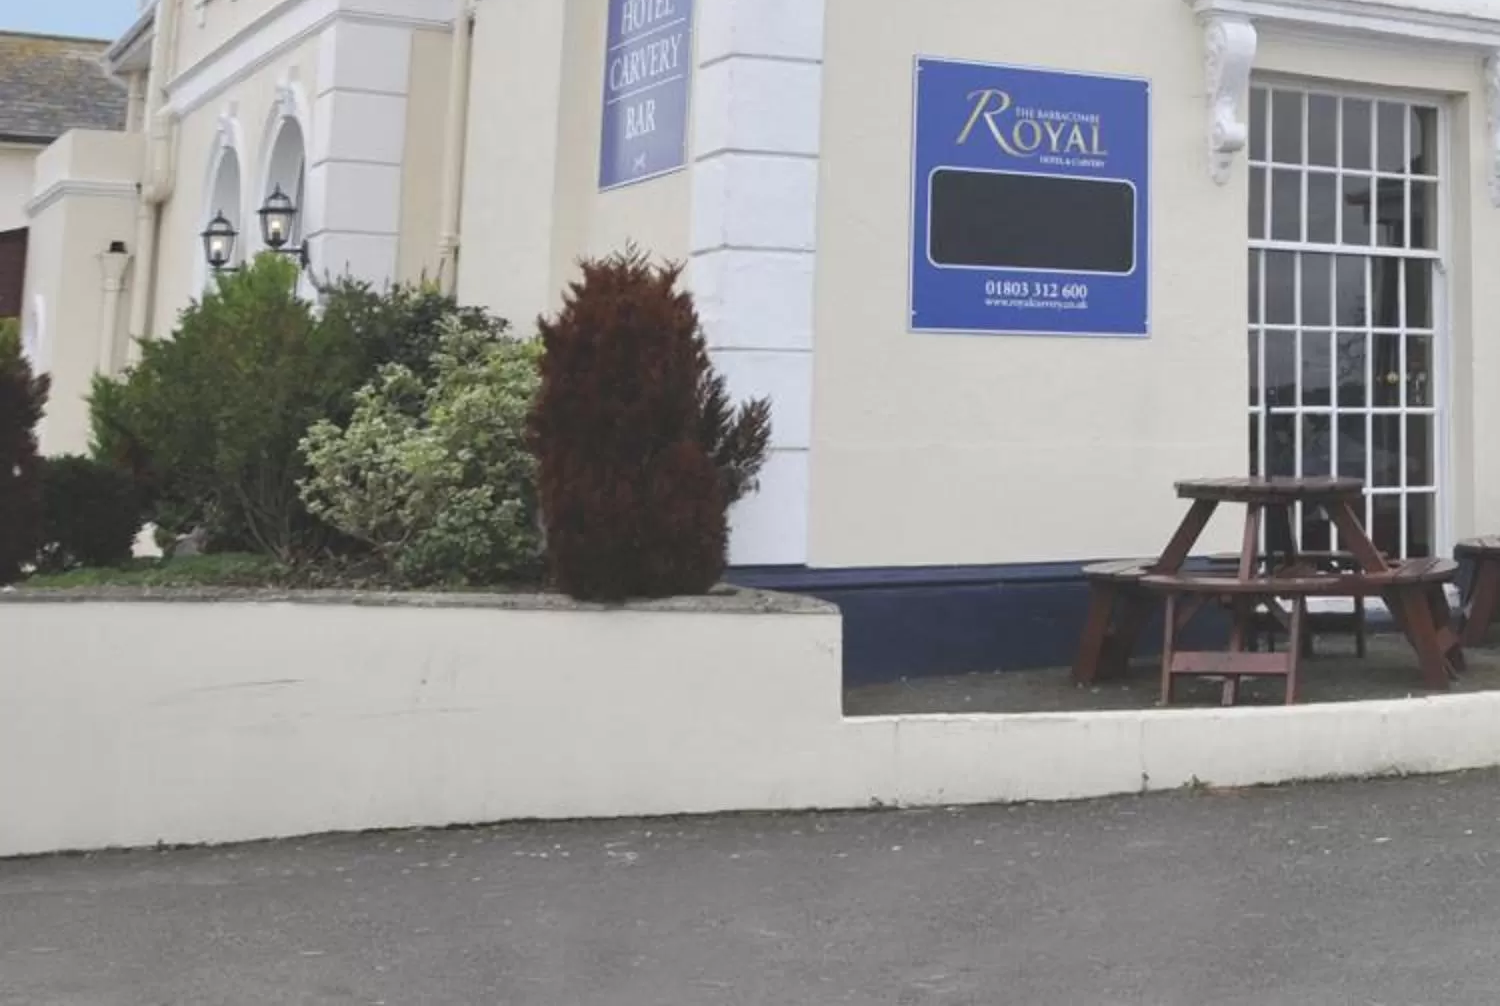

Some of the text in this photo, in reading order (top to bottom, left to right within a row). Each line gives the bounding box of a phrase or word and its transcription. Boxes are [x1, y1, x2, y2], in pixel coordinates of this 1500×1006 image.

[609, 33, 683, 91] CARVERY
[624, 98, 656, 140] BAR
[955, 87, 1108, 158] ROYAL
[1015, 105, 1035, 119] THE
[984, 280, 1089, 300] 01803 312 600
